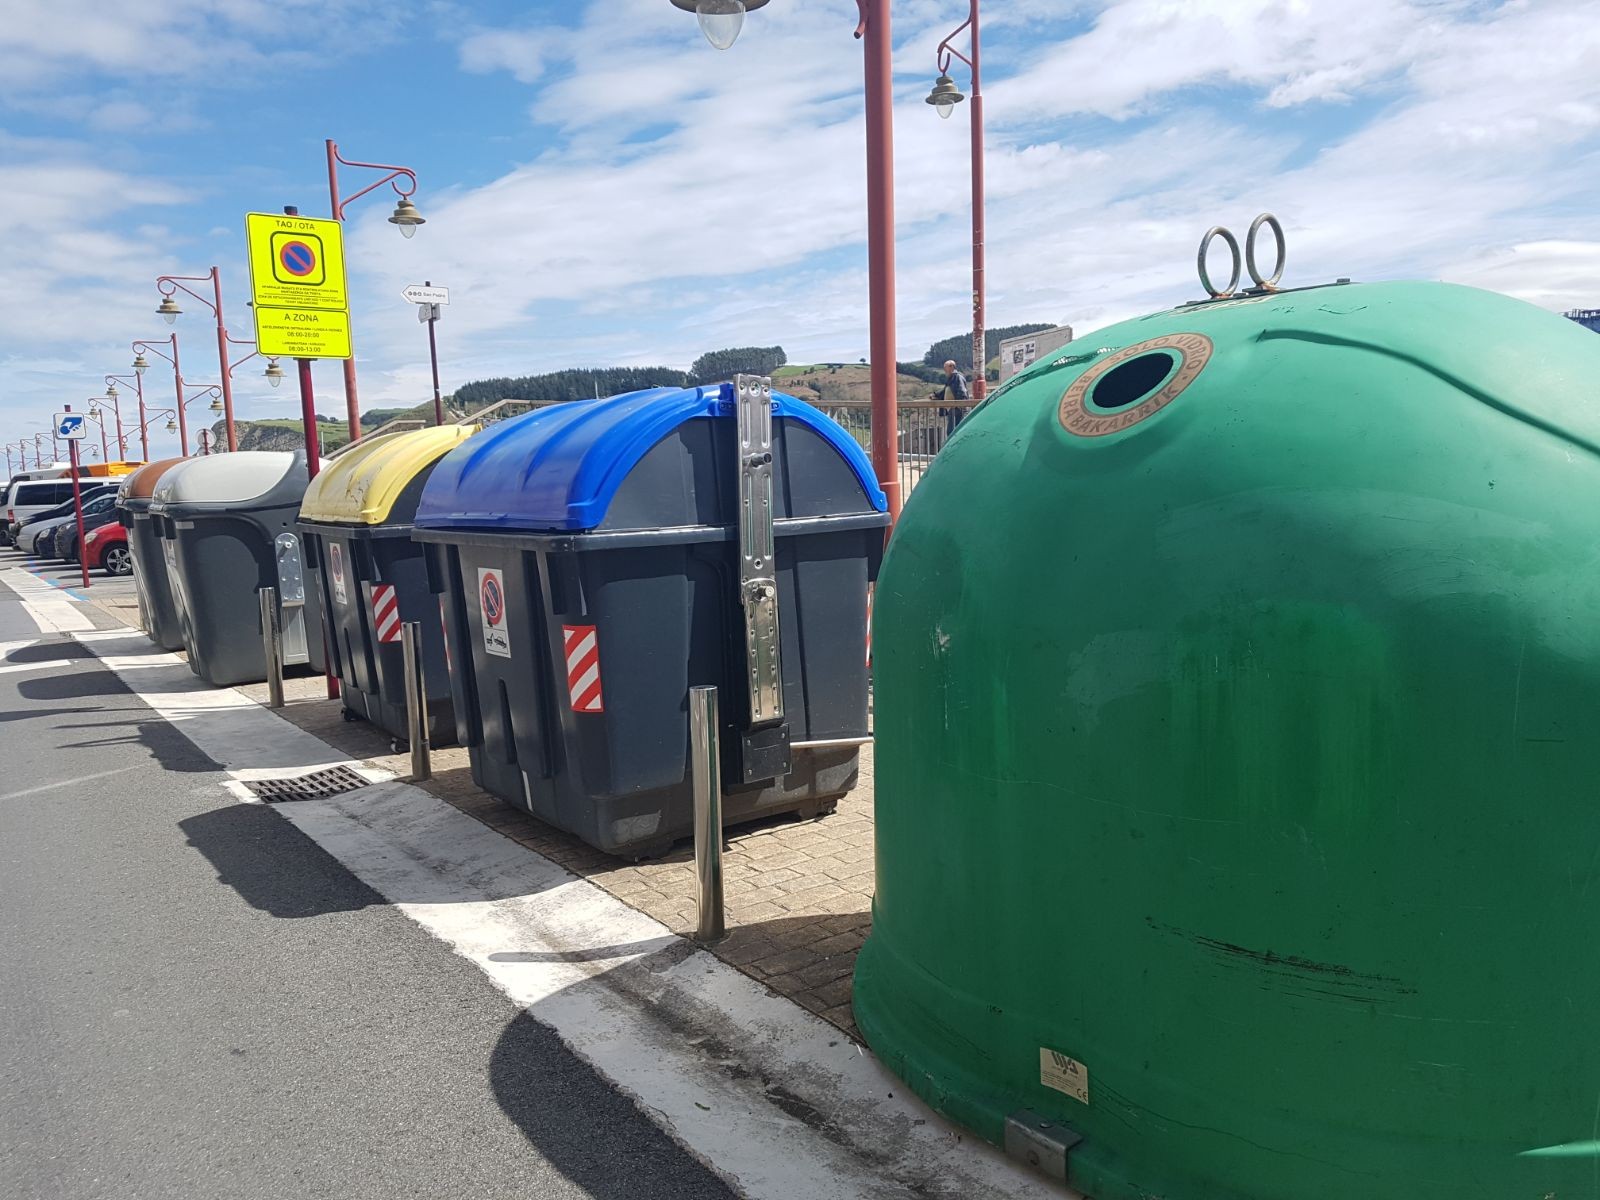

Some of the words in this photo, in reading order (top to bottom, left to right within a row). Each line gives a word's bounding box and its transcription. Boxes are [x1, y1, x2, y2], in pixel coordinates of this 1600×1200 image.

[275, 220, 292, 229] TAO
[299, 222, 315, 230] OTA
[284, 313, 291, 321] A
[293, 314, 319, 323] ZONA
[1109, 338, 1170, 363] SOLO
[1176, 335, 1208, 370] VIDRIO
